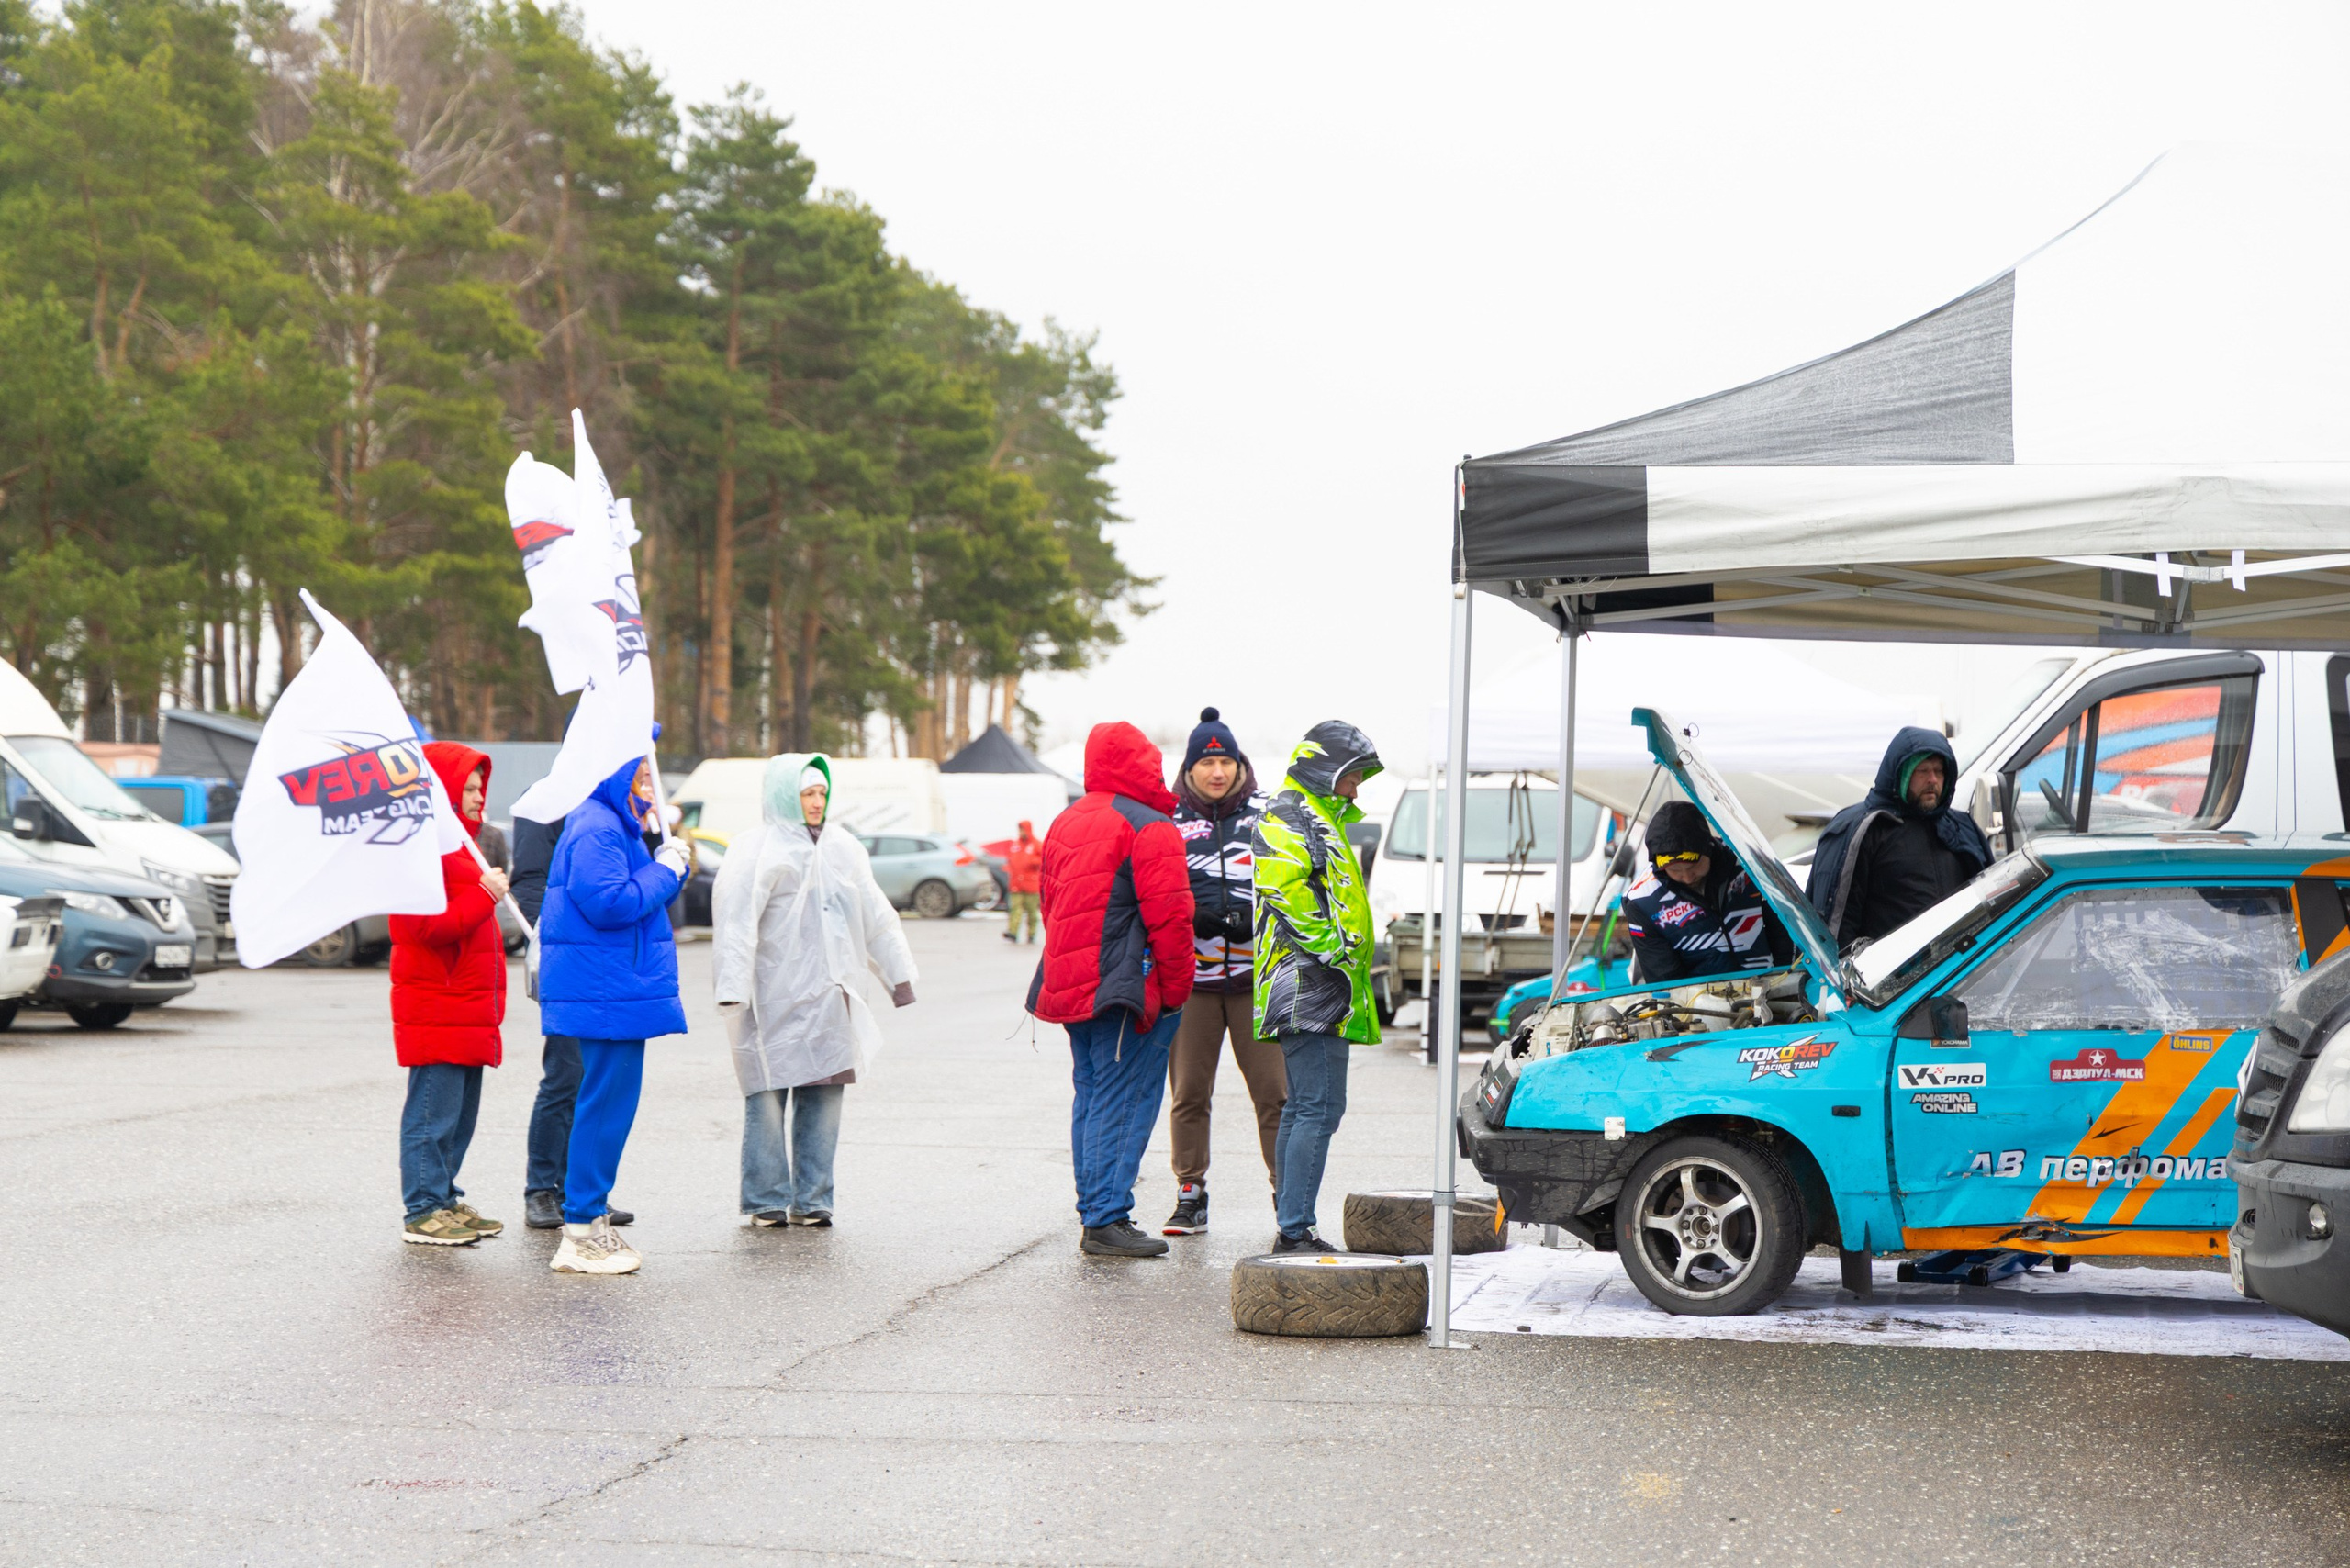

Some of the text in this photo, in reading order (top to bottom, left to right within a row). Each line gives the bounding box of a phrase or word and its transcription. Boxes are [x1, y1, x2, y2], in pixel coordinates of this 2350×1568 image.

[2172, 1036, 2210, 1051] ÖHLINS
[1739, 1043, 1837, 1063] KOKOREV
[1757, 1060, 1819, 1072] RACING TEAM
[1943, 1074, 1985, 1085] PRO
[1910, 1092, 1971, 1103] AMAZING
[1921, 1103, 1978, 1114] ONLINE
